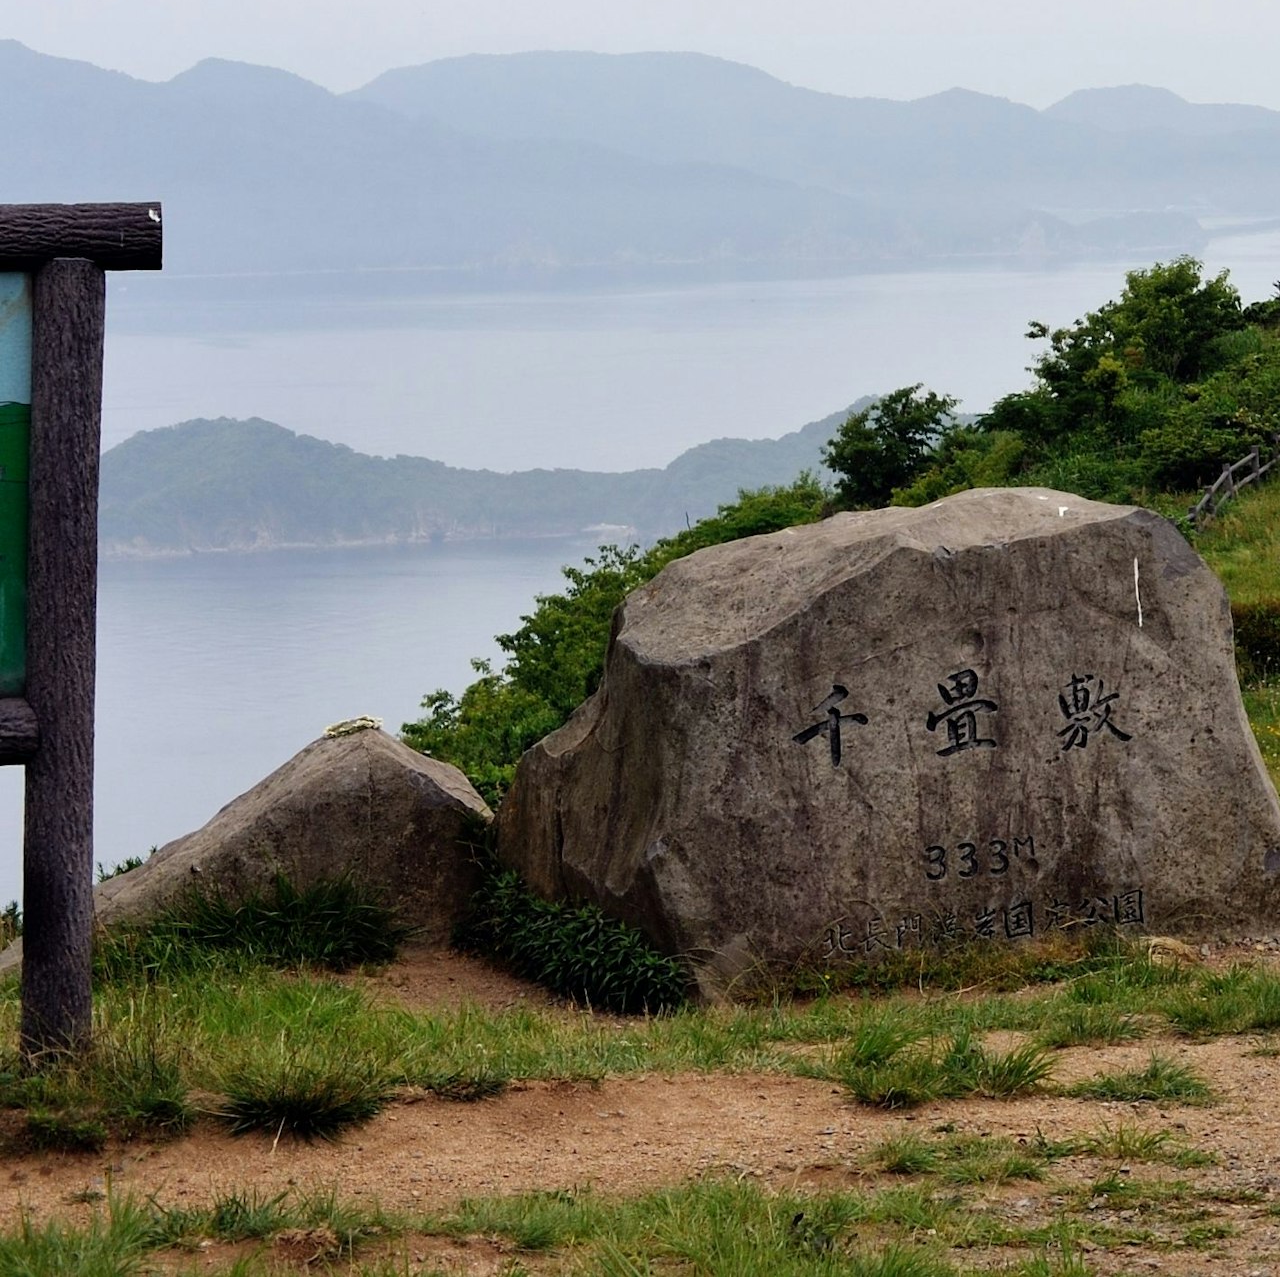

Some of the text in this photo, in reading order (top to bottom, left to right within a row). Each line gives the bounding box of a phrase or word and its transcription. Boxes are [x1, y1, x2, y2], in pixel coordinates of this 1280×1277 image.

[792, 668, 1133, 768] 千畳敷
[923, 835, 1036, 881] 333M
